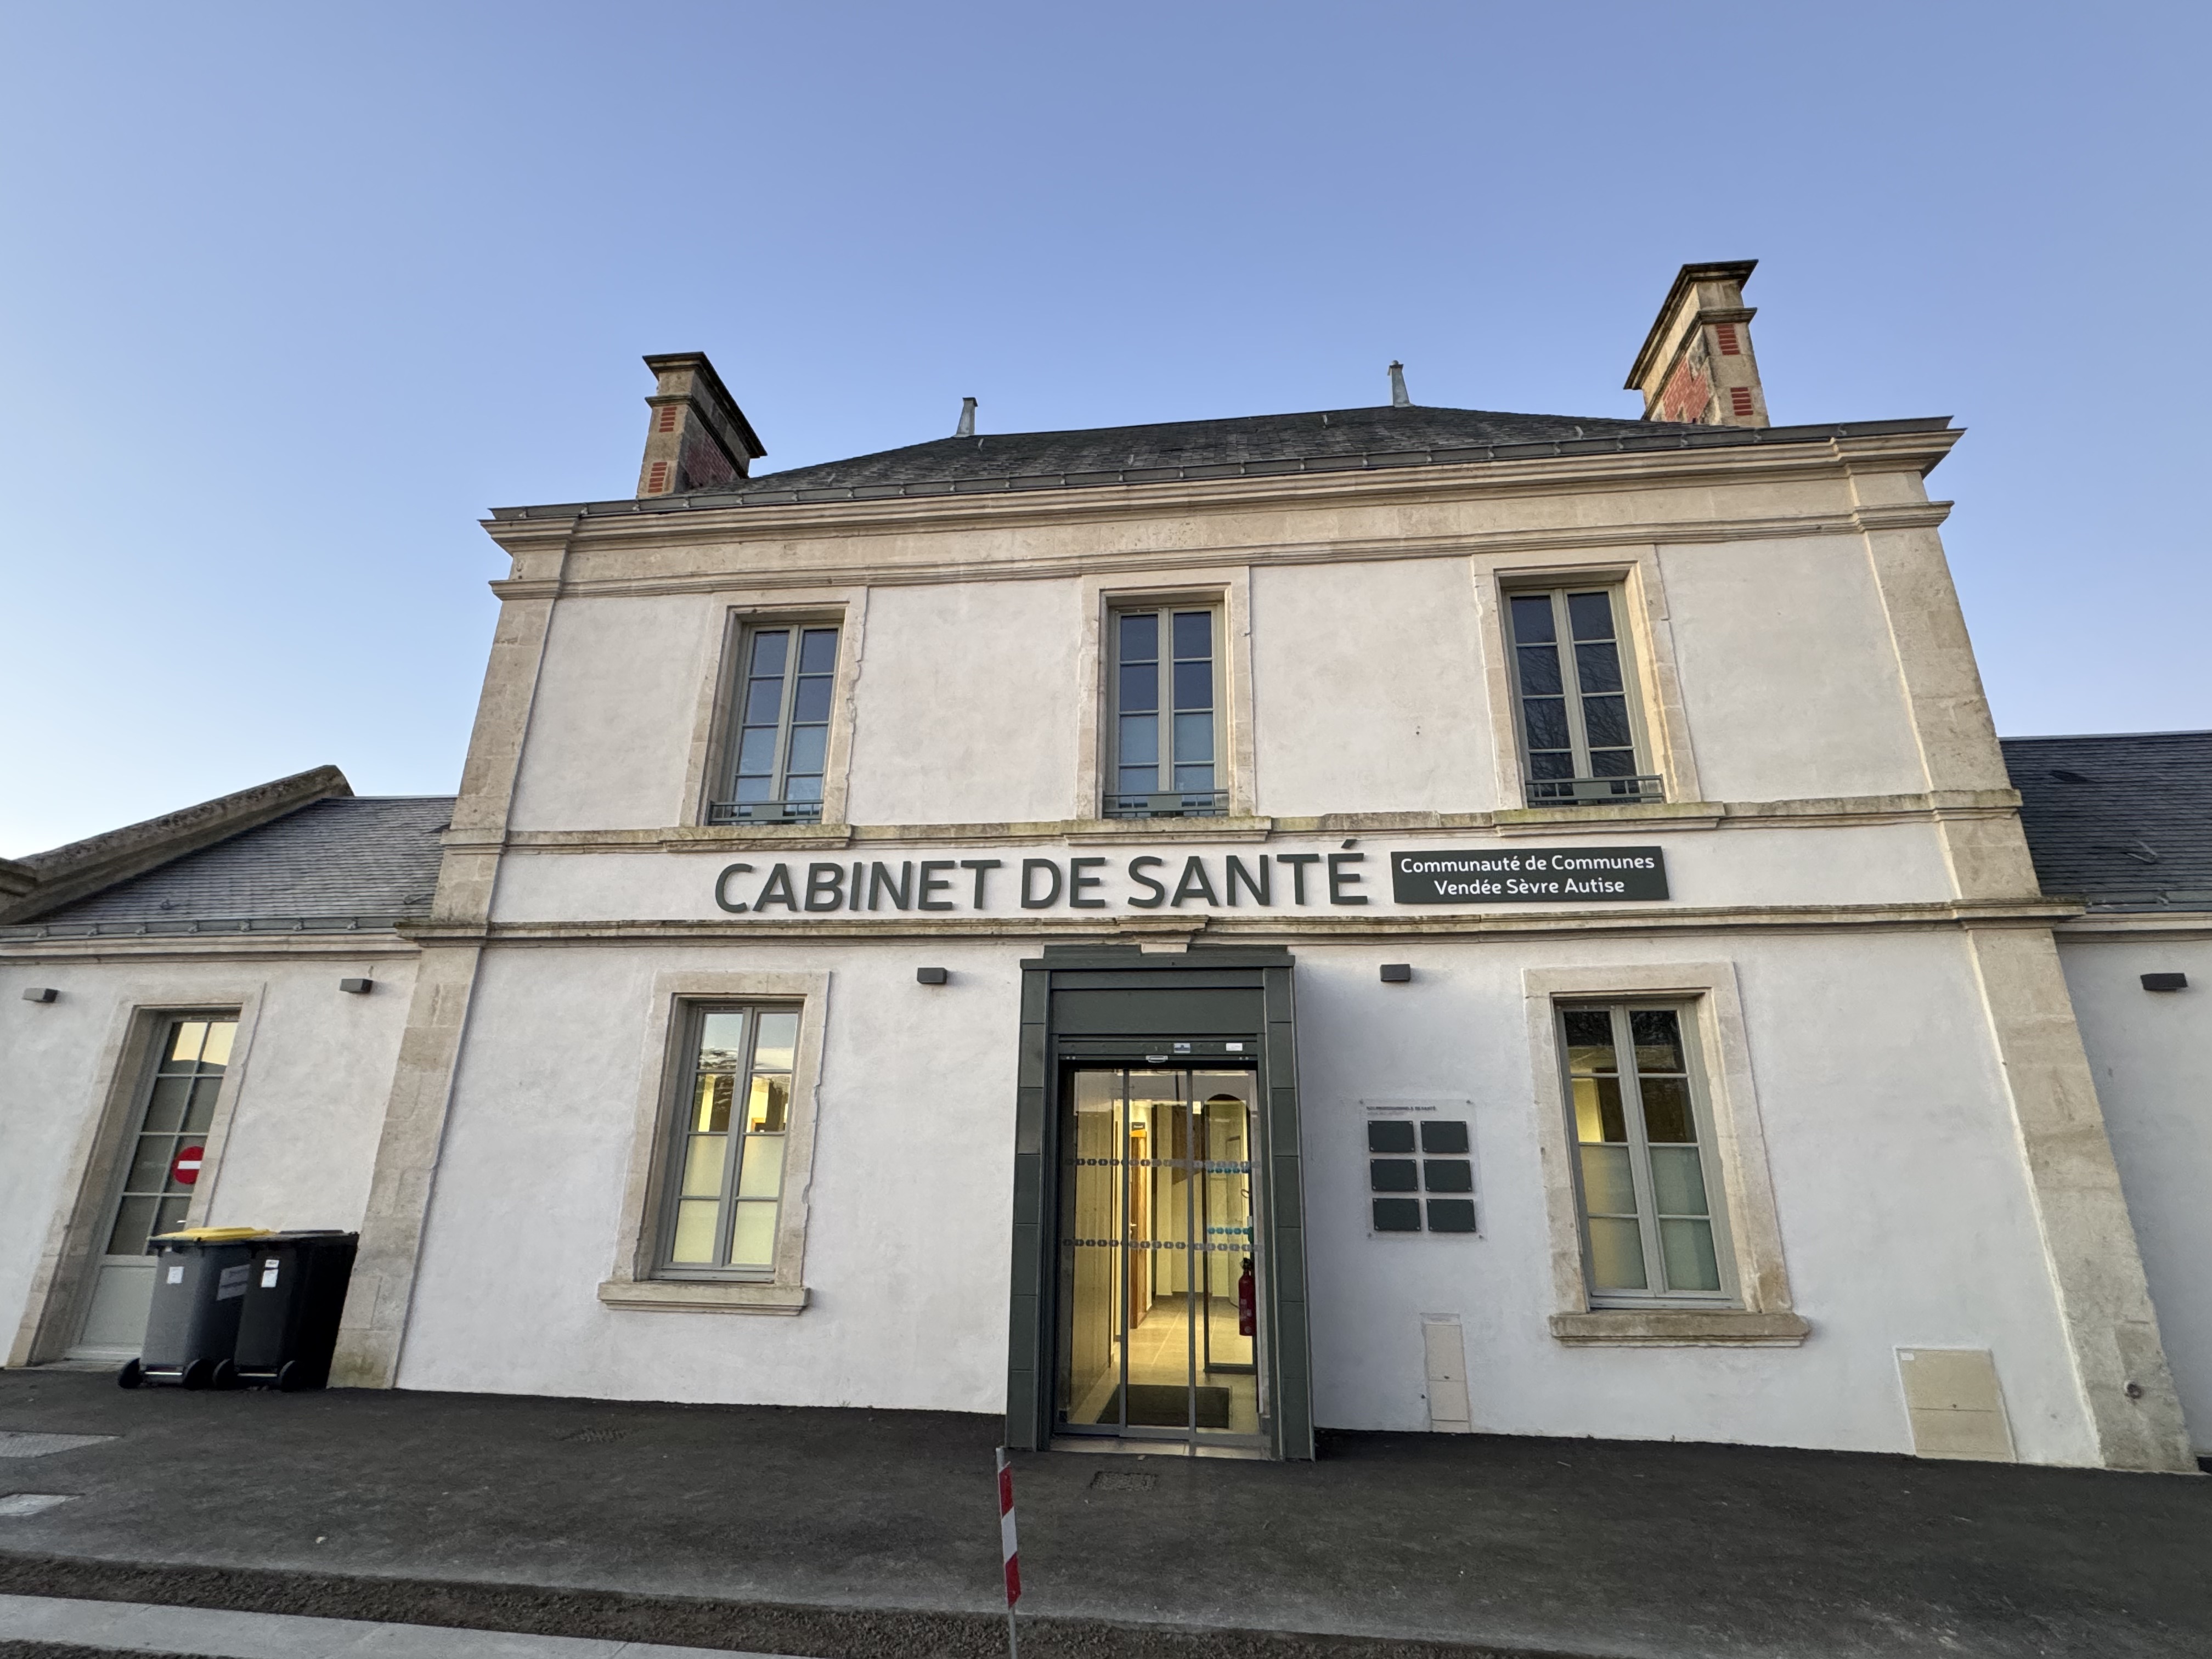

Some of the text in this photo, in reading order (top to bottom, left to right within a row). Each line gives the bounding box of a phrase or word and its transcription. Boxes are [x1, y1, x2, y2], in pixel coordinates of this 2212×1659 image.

[1401, 855, 1655, 873] Communauté de Communes
[715, 839, 1368, 912] CABINET DE SANTÉ
[1434, 878, 1625, 895] Vendée Sèvre Autise
